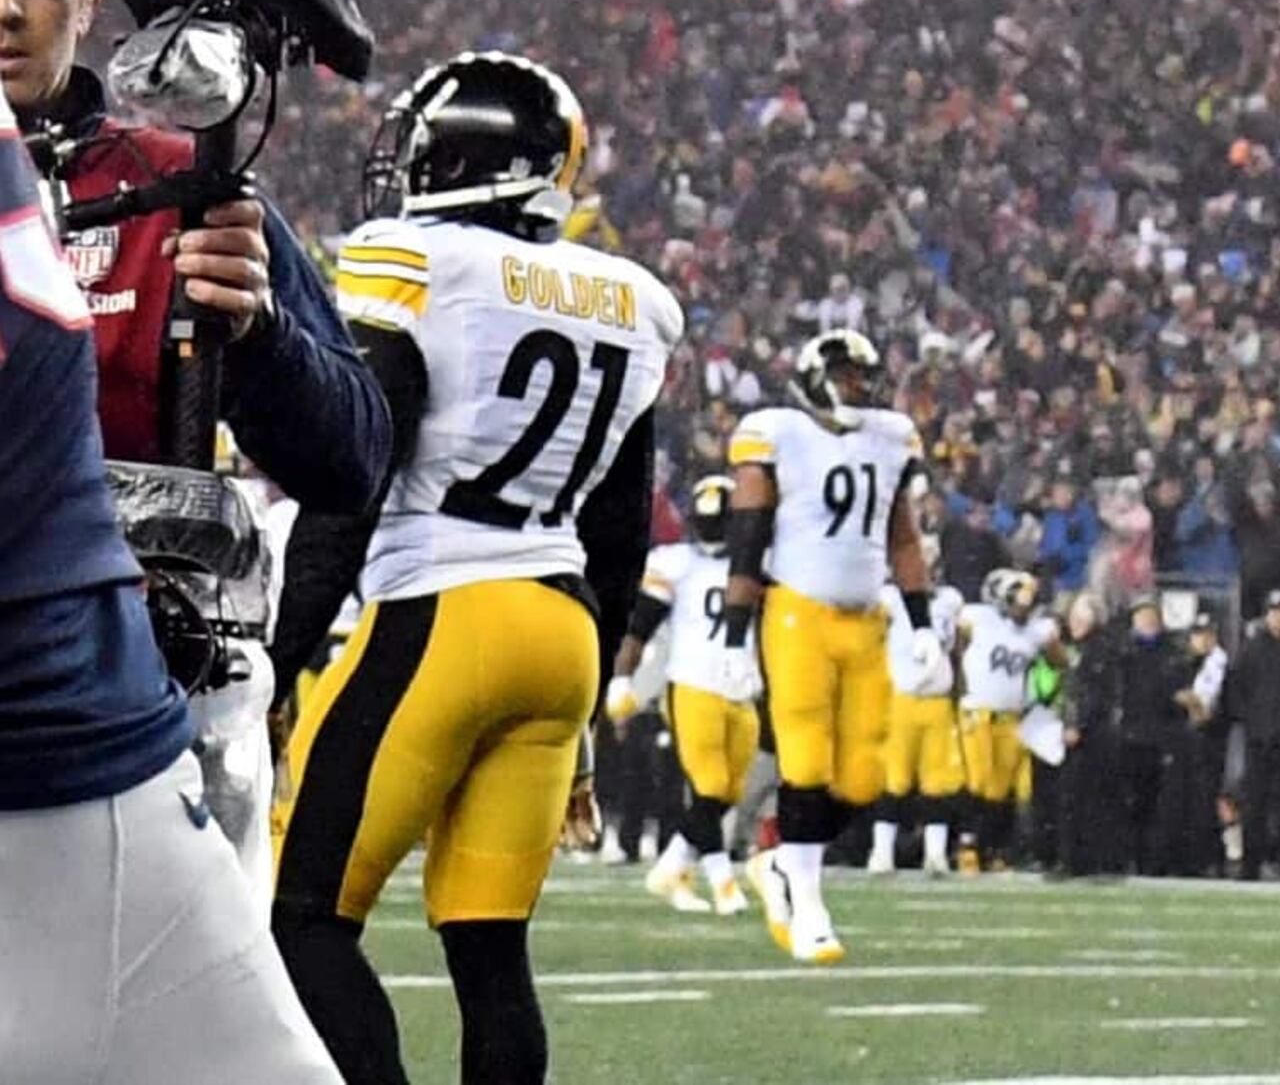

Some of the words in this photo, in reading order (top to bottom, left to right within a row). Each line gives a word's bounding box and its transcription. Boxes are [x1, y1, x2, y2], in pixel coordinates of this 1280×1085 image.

[502, 254, 637, 332] GOLDEN
[440, 329, 631, 531] 21
[822, 462, 878, 538] 91
